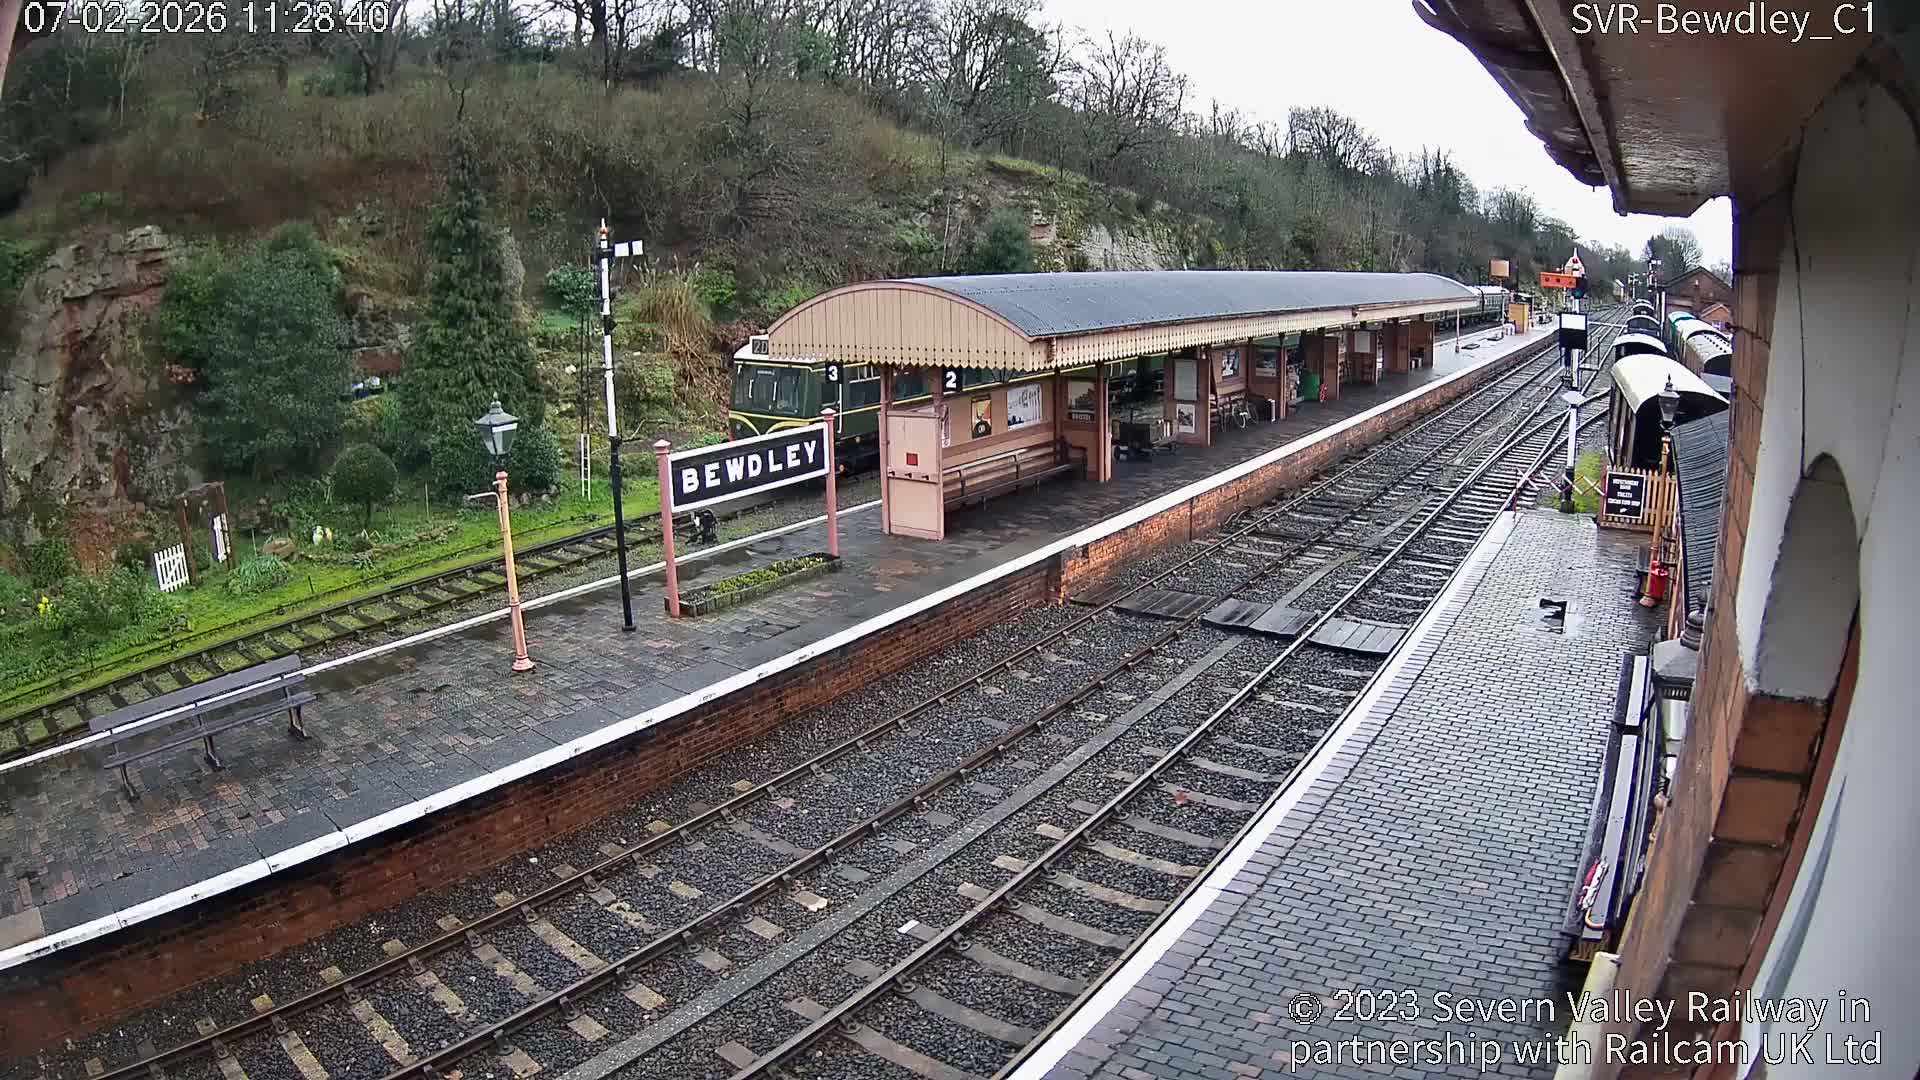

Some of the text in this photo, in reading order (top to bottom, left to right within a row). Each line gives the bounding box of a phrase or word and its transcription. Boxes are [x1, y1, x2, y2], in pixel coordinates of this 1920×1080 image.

[828, 365, 838, 381] 3
[946, 371, 957, 388] 2
[681, 440, 817, 494] BEWDLEY
